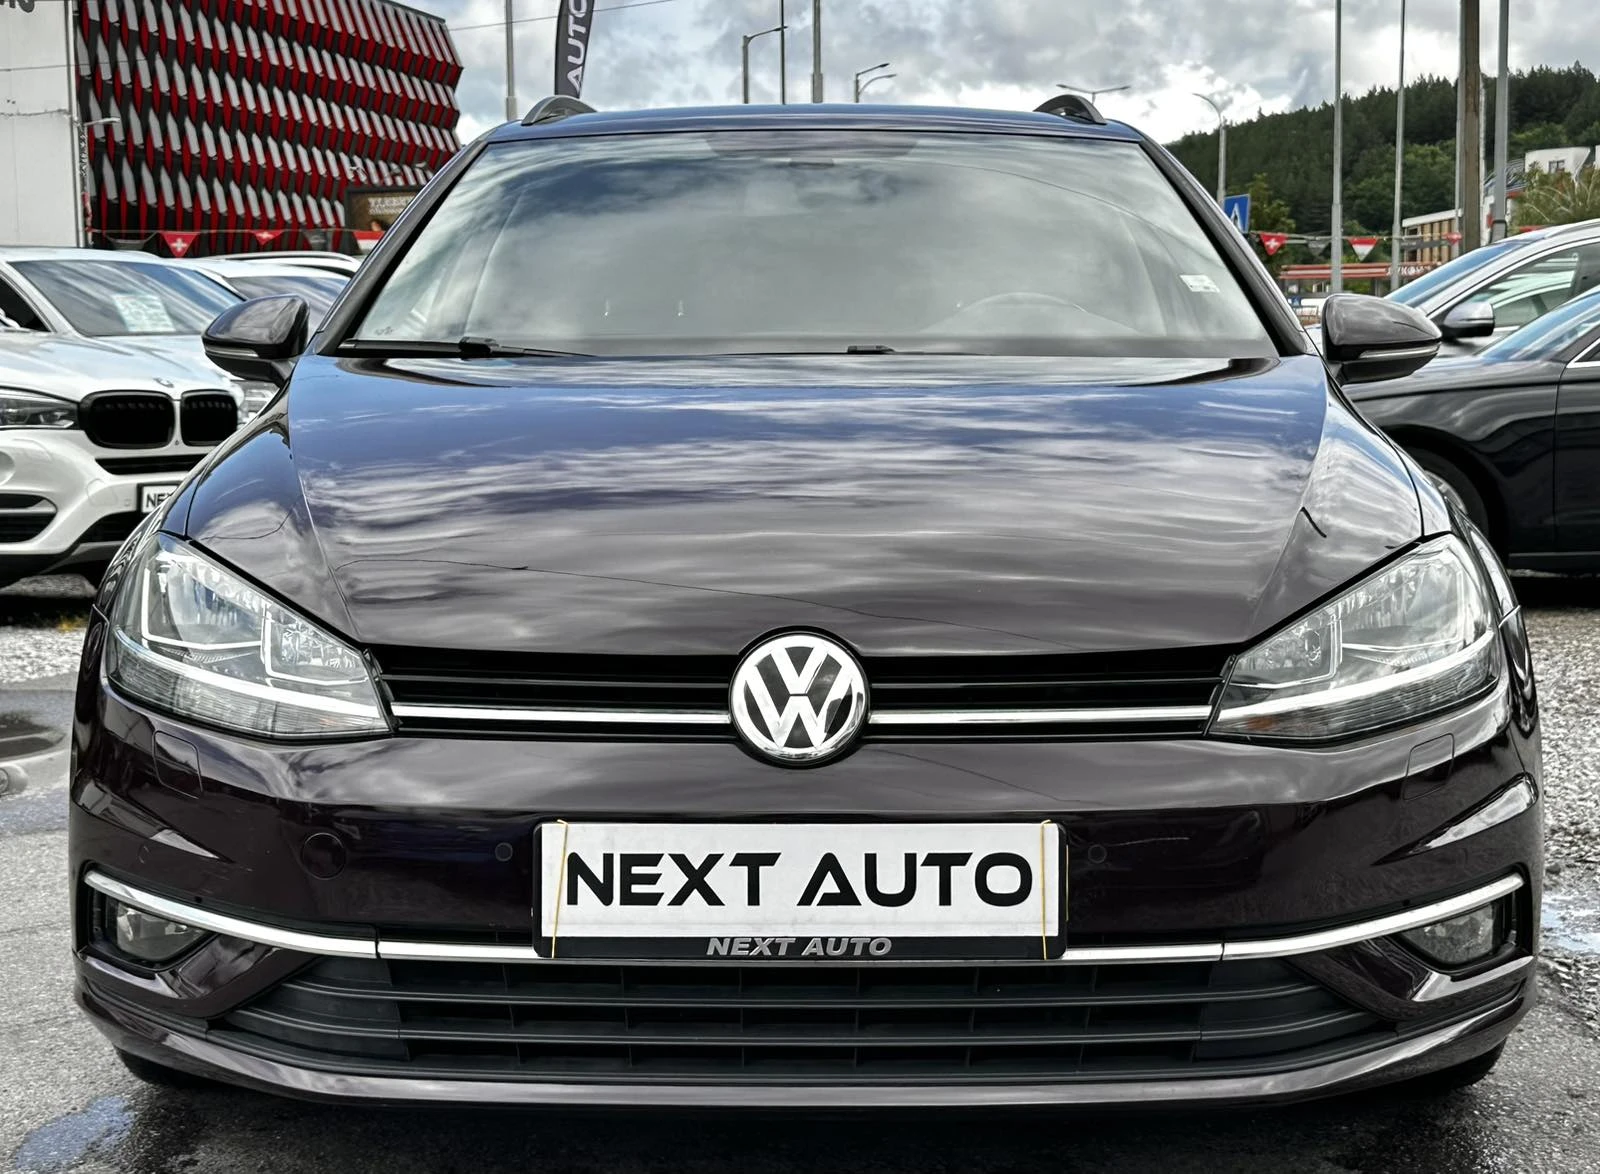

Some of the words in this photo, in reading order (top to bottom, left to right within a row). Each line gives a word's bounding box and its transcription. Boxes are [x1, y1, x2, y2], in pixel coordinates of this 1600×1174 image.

[567, 852, 781, 907] NEXT
[797, 852, 1033, 907] AUTO
[706, 937, 796, 956] NEXT
[801, 937, 892, 956] AUTO
